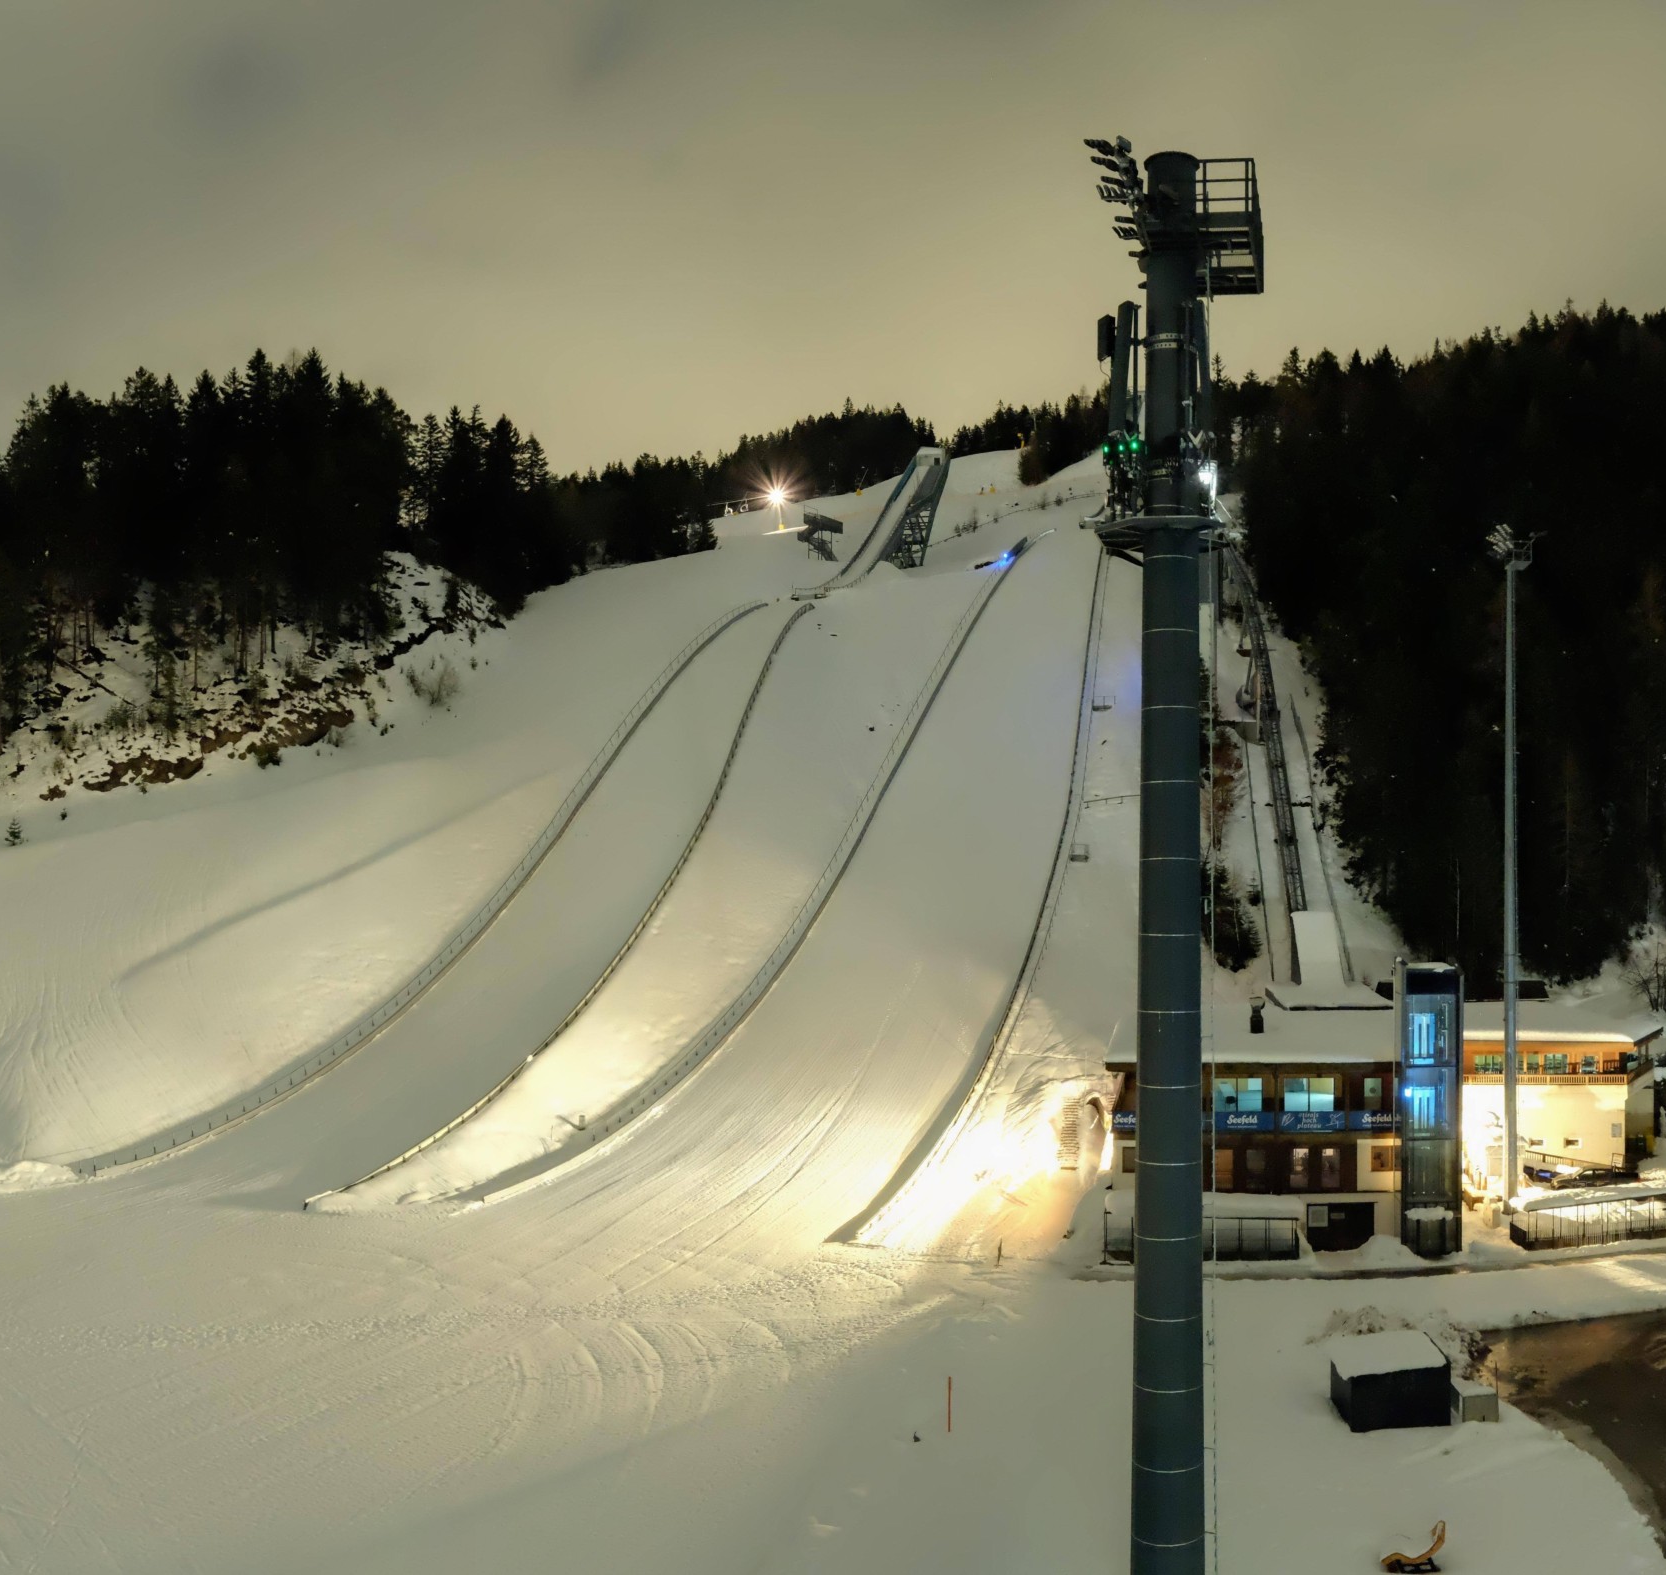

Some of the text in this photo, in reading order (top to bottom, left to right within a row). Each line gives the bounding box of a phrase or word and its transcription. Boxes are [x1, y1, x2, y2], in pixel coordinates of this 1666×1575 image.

[1114, 1113, 1136, 1125] Seefe
[1227, 1114, 1258, 1125] Seefeld
[1362, 1113, 1392, 1123] Seefeld
[1297, 1122, 1322, 1130] plateau
